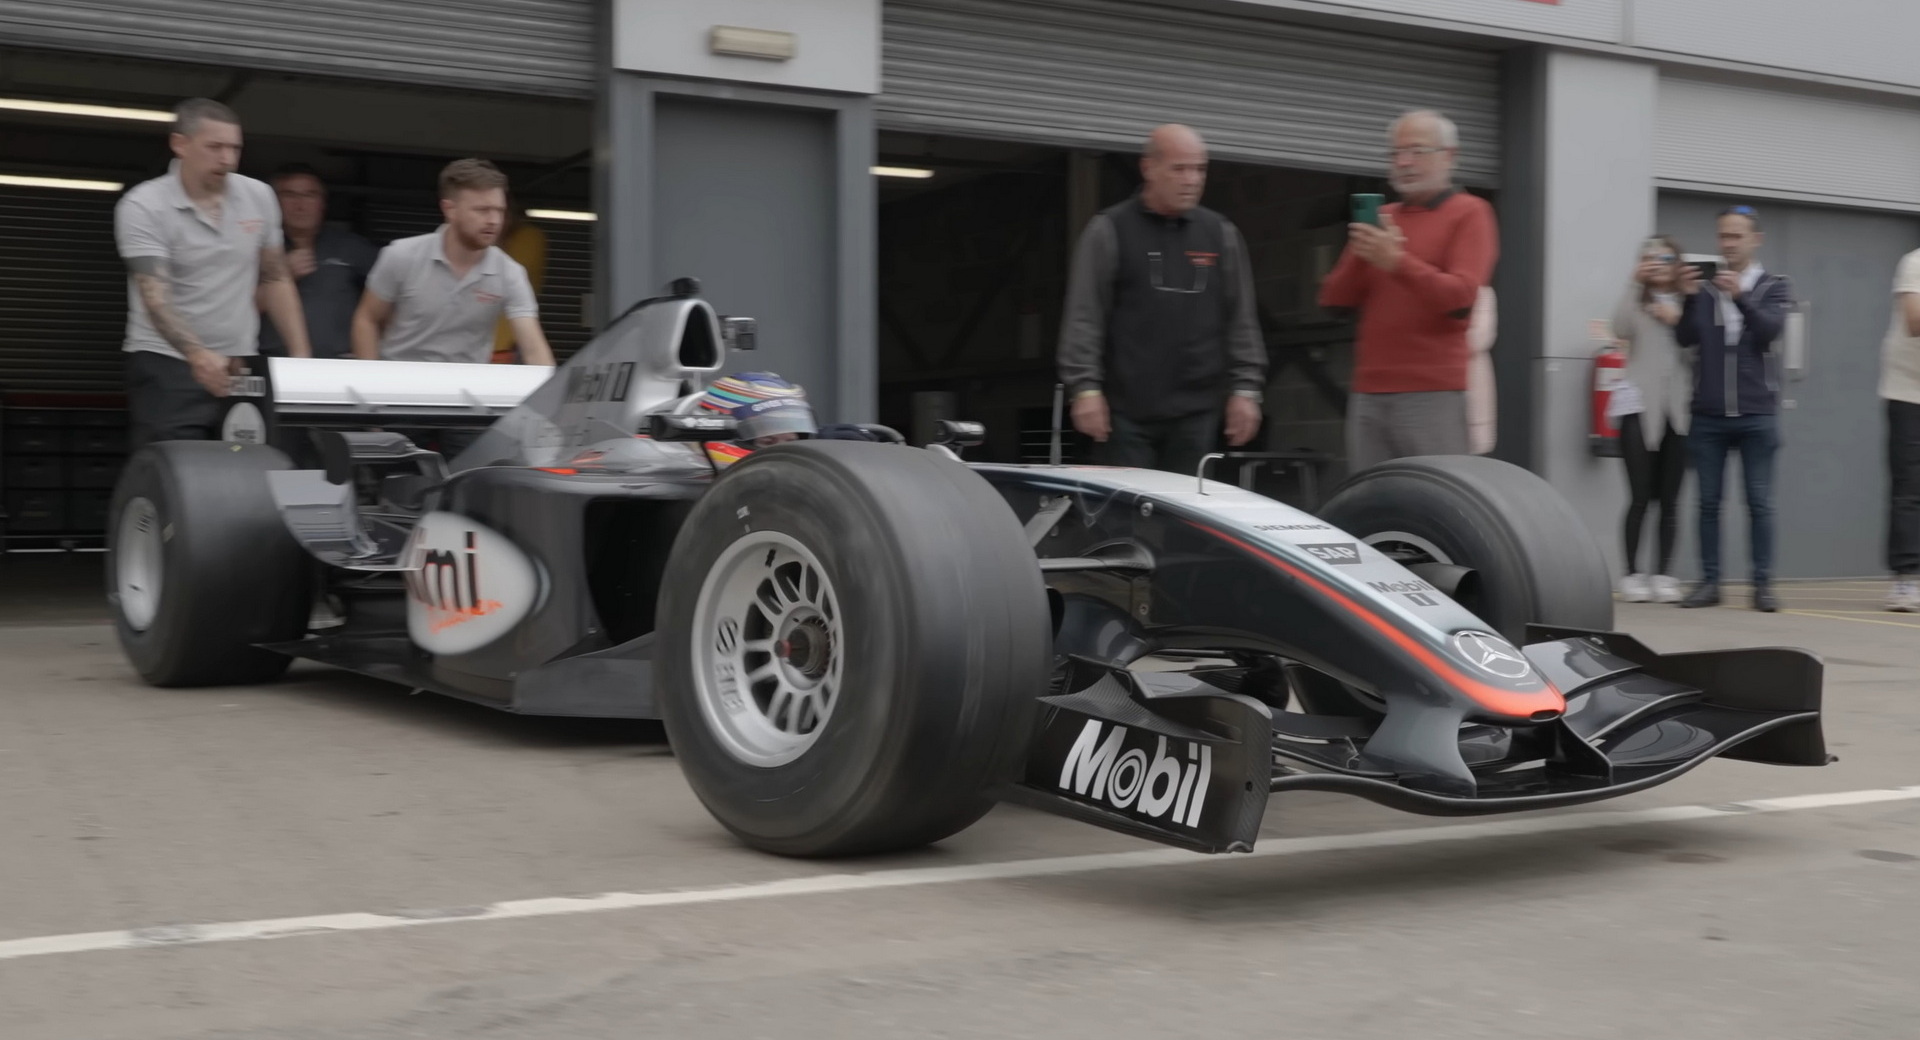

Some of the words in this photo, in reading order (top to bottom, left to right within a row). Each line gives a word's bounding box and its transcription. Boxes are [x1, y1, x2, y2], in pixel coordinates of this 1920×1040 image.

[1253, 523, 1331, 532] SIEMENS
[1305, 545, 1356, 560] SAP
[1366, 579, 1437, 594] Mobil
[1402, 592, 1440, 607] 1
[1058, 718, 1212, 829] Mobil
